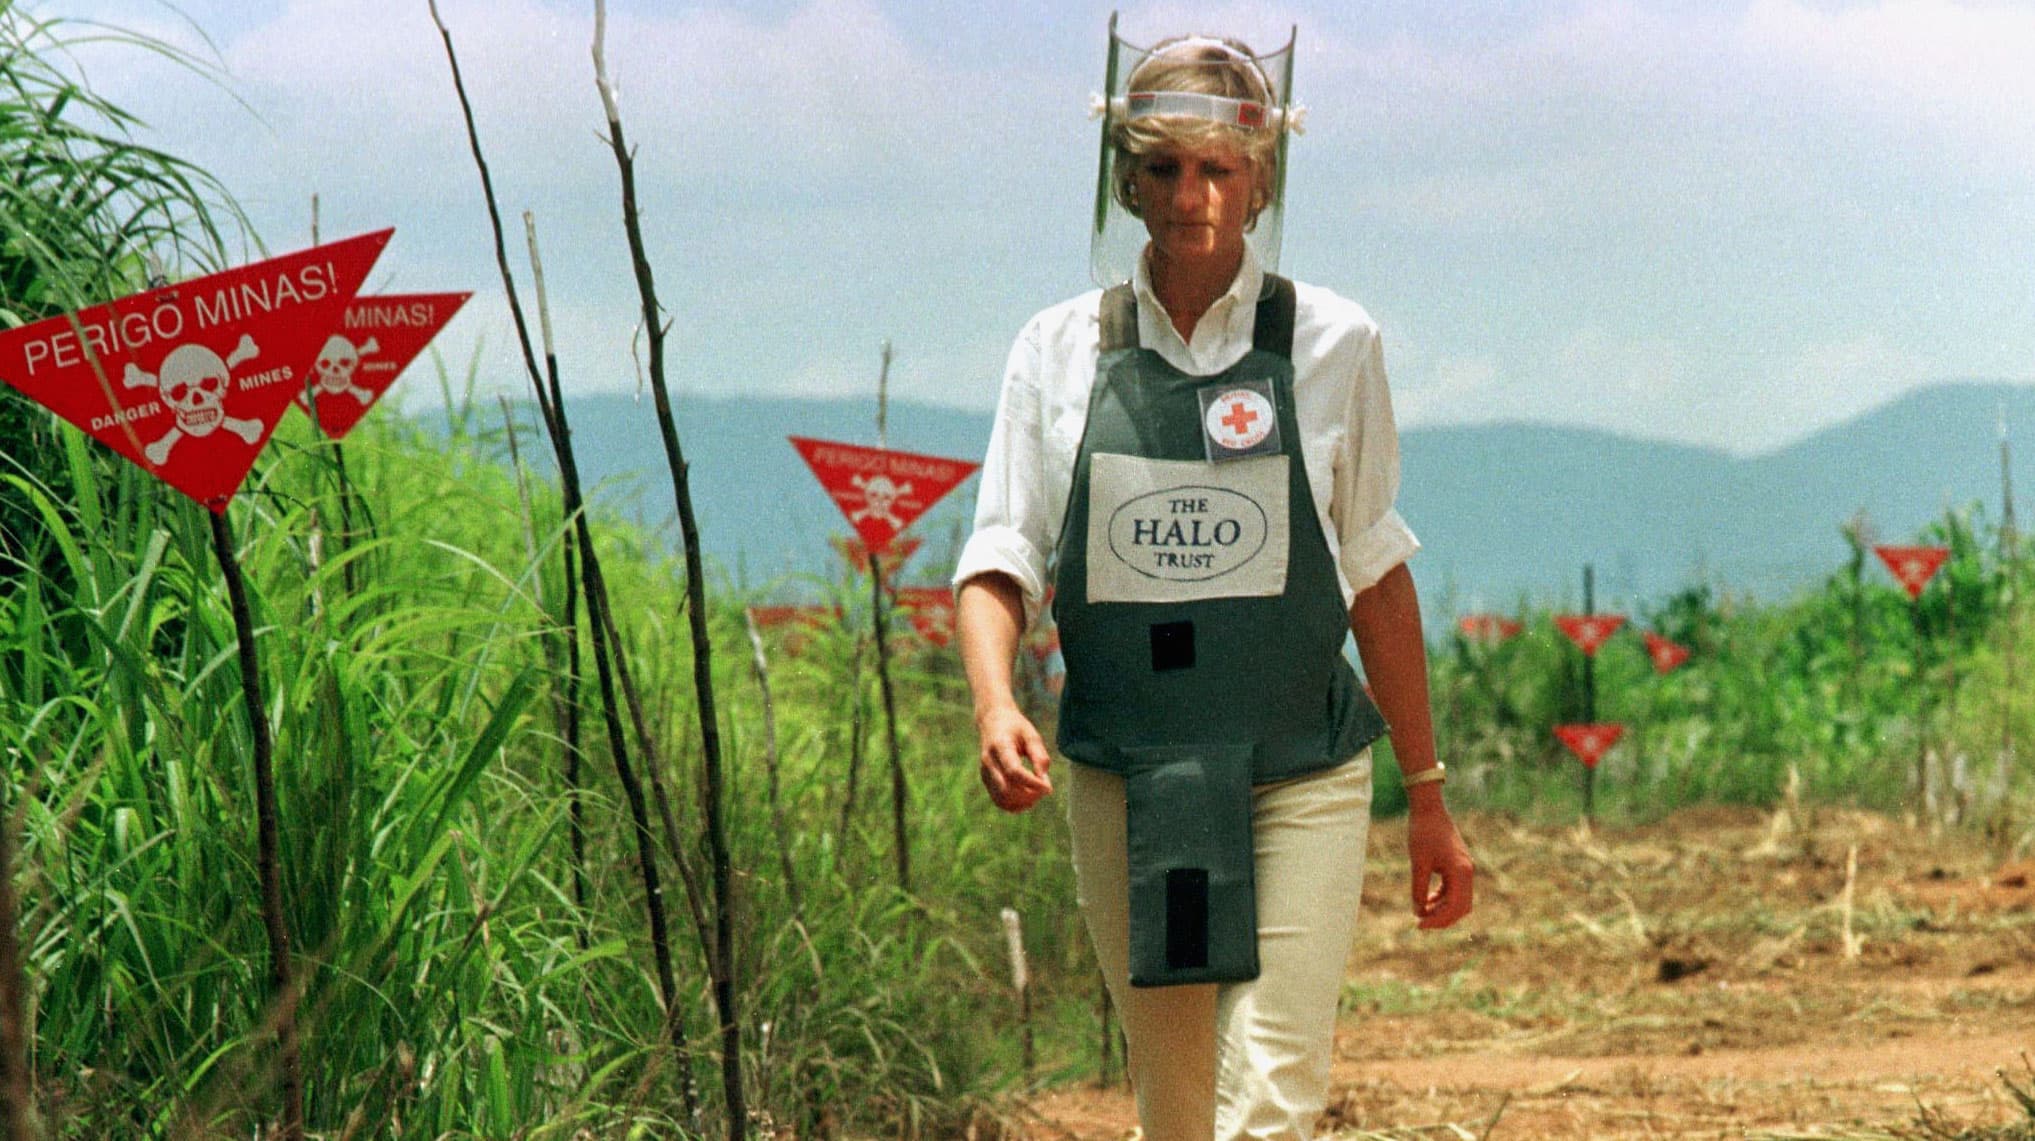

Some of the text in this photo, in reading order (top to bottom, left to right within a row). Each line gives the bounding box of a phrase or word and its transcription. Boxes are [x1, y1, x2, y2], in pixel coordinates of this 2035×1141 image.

[23, 261, 339, 376] PERIGO MINAS!
[344, 303, 435, 329] MINAS!
[238, 365, 294, 392] MINES
[90, 401, 162, 431] DANGER
[1168, 498, 1209, 514] THE
[1132, 518, 1241, 546] HALO
[1154, 551, 1215, 569] TRUST
